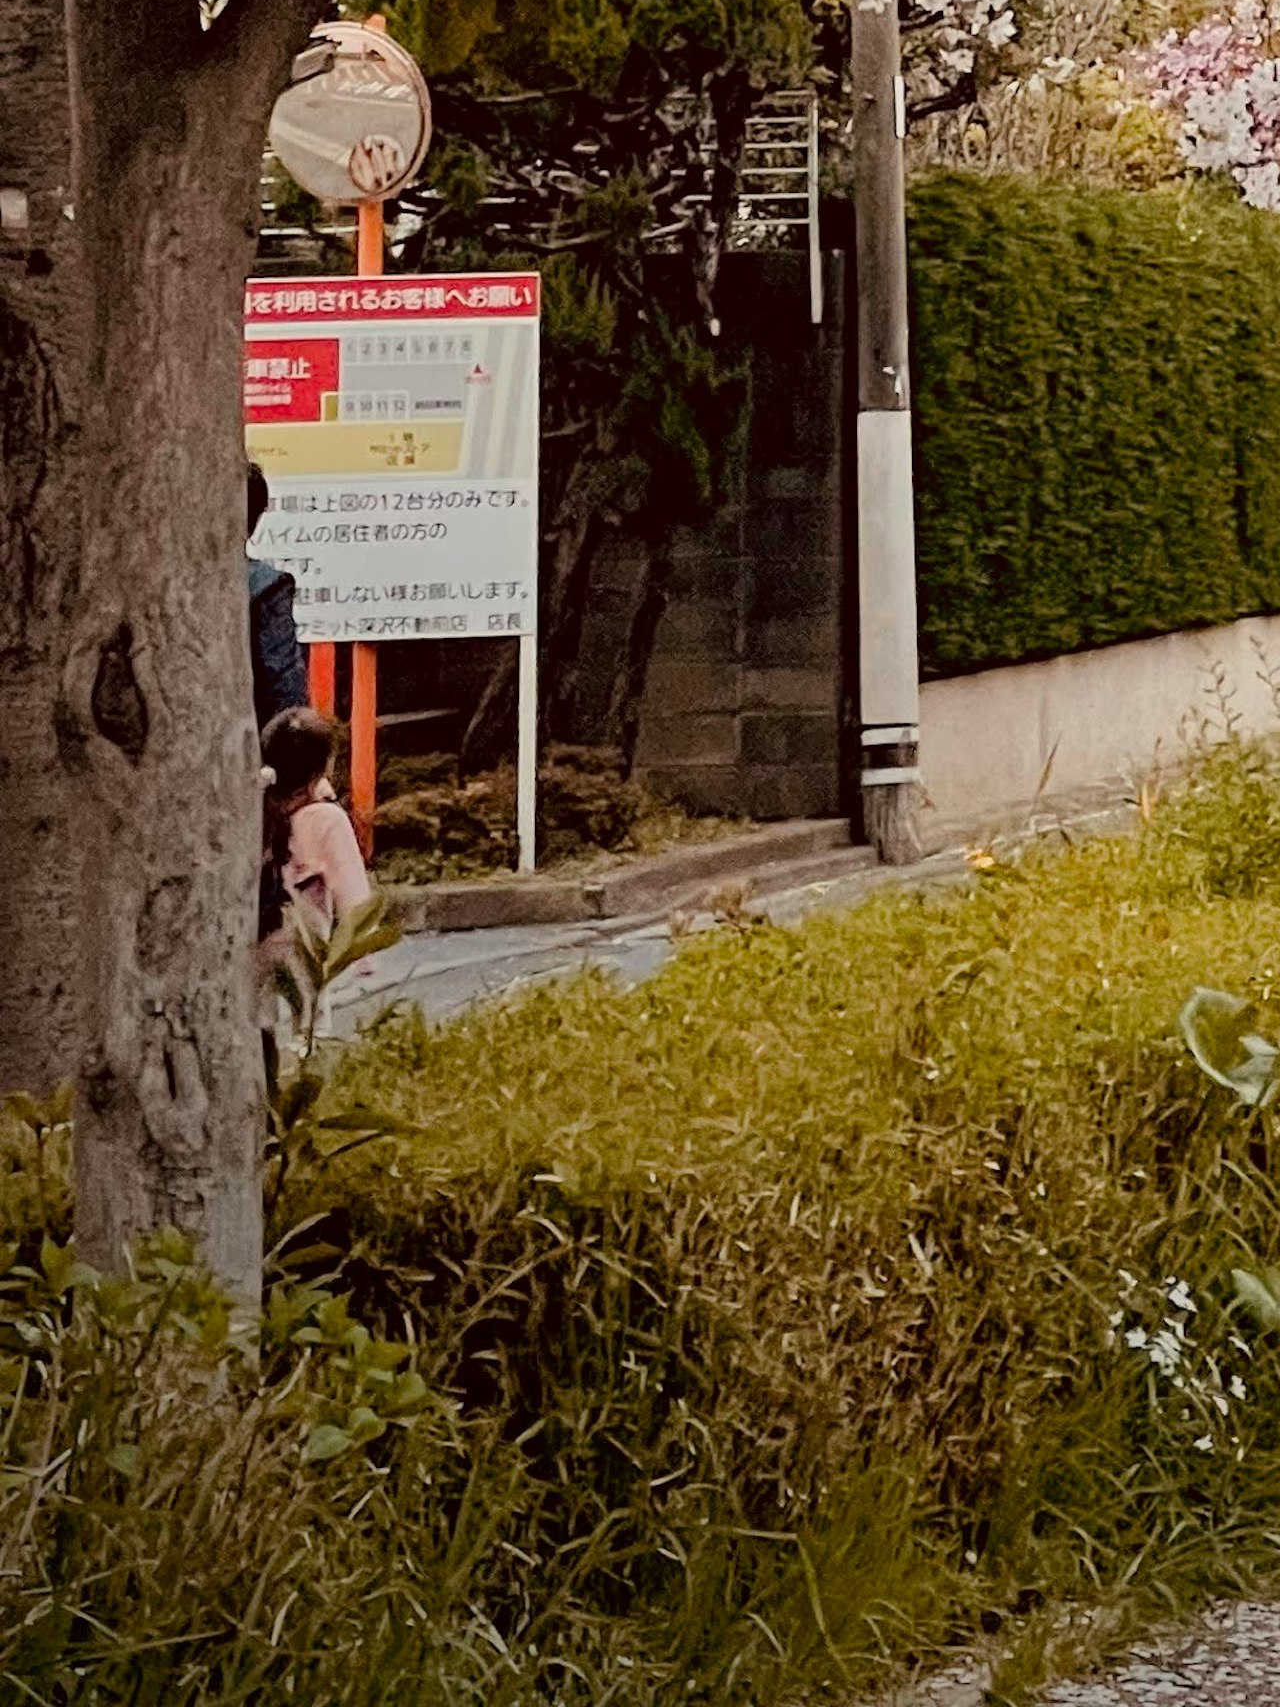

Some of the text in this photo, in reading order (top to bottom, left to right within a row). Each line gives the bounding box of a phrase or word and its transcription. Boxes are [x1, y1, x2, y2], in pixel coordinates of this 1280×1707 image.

[245, 286, 532, 315] を利用されるお客様へお願い
[396, 342, 404, 352] 4
[250, 523, 447, 546] ハイムの居住者の方の
[488, 613, 520, 630] 店長
